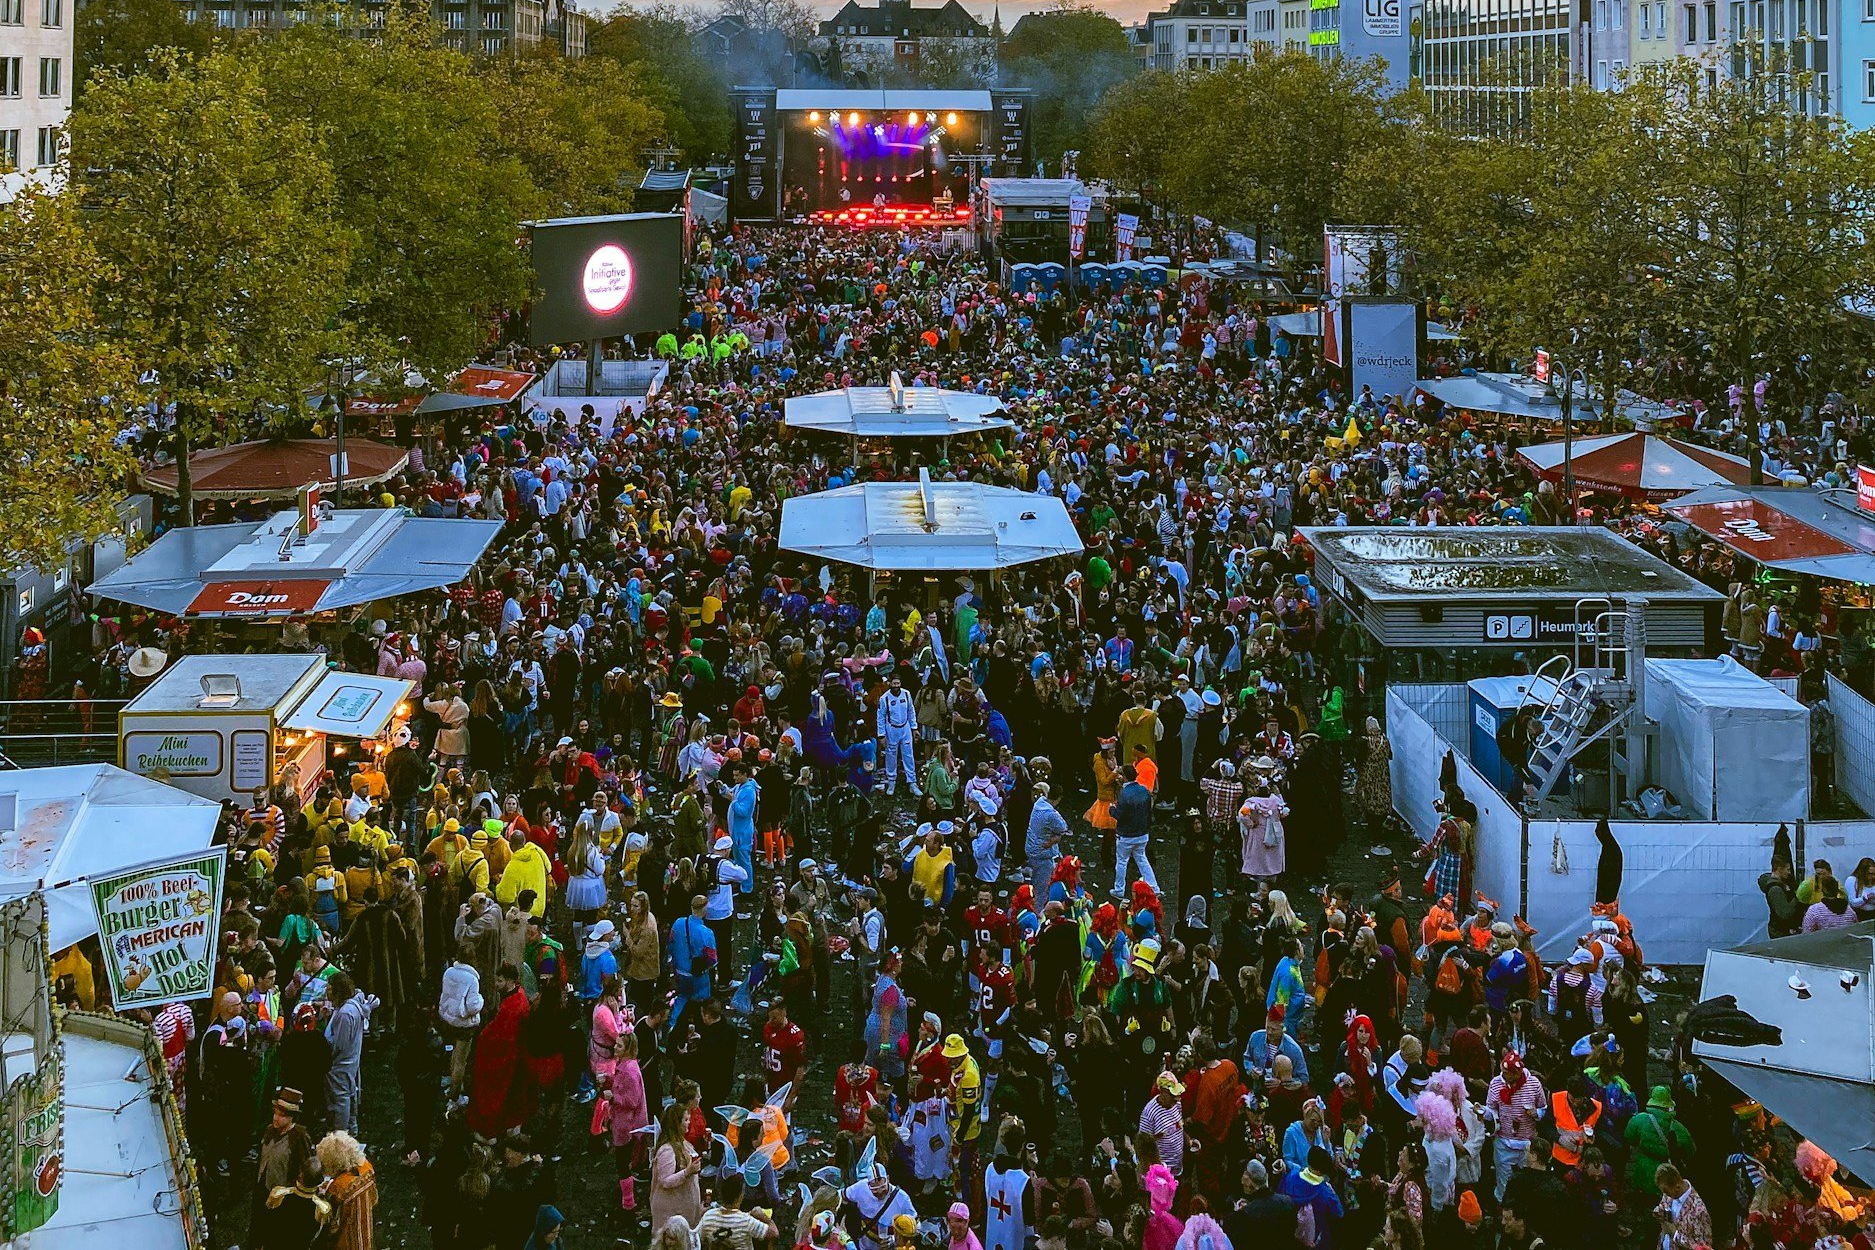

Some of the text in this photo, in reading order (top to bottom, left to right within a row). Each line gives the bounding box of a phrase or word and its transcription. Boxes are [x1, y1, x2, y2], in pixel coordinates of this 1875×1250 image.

[1365, 0, 1399, 17] LIG
[1070, 210, 1087, 227] WC
[1117, 229, 1134, 245] WC
[591, 267, 626, 280] Initiative
[1357, 355, 1412, 368] @wdrjeck
[225, 592, 288, 604] Dom
[1540, 620, 1599, 632] Heumark
[157, 736, 189, 751] Mini
[137, 753, 208, 769] Reibekuchen
[119, 881, 158, 904] 100%
[104, 896, 182, 936] Burger
[116, 921, 205, 959] AMERICAN
[150, 942, 188, 975] Hot
[157, 960, 209, 997] Dogs
